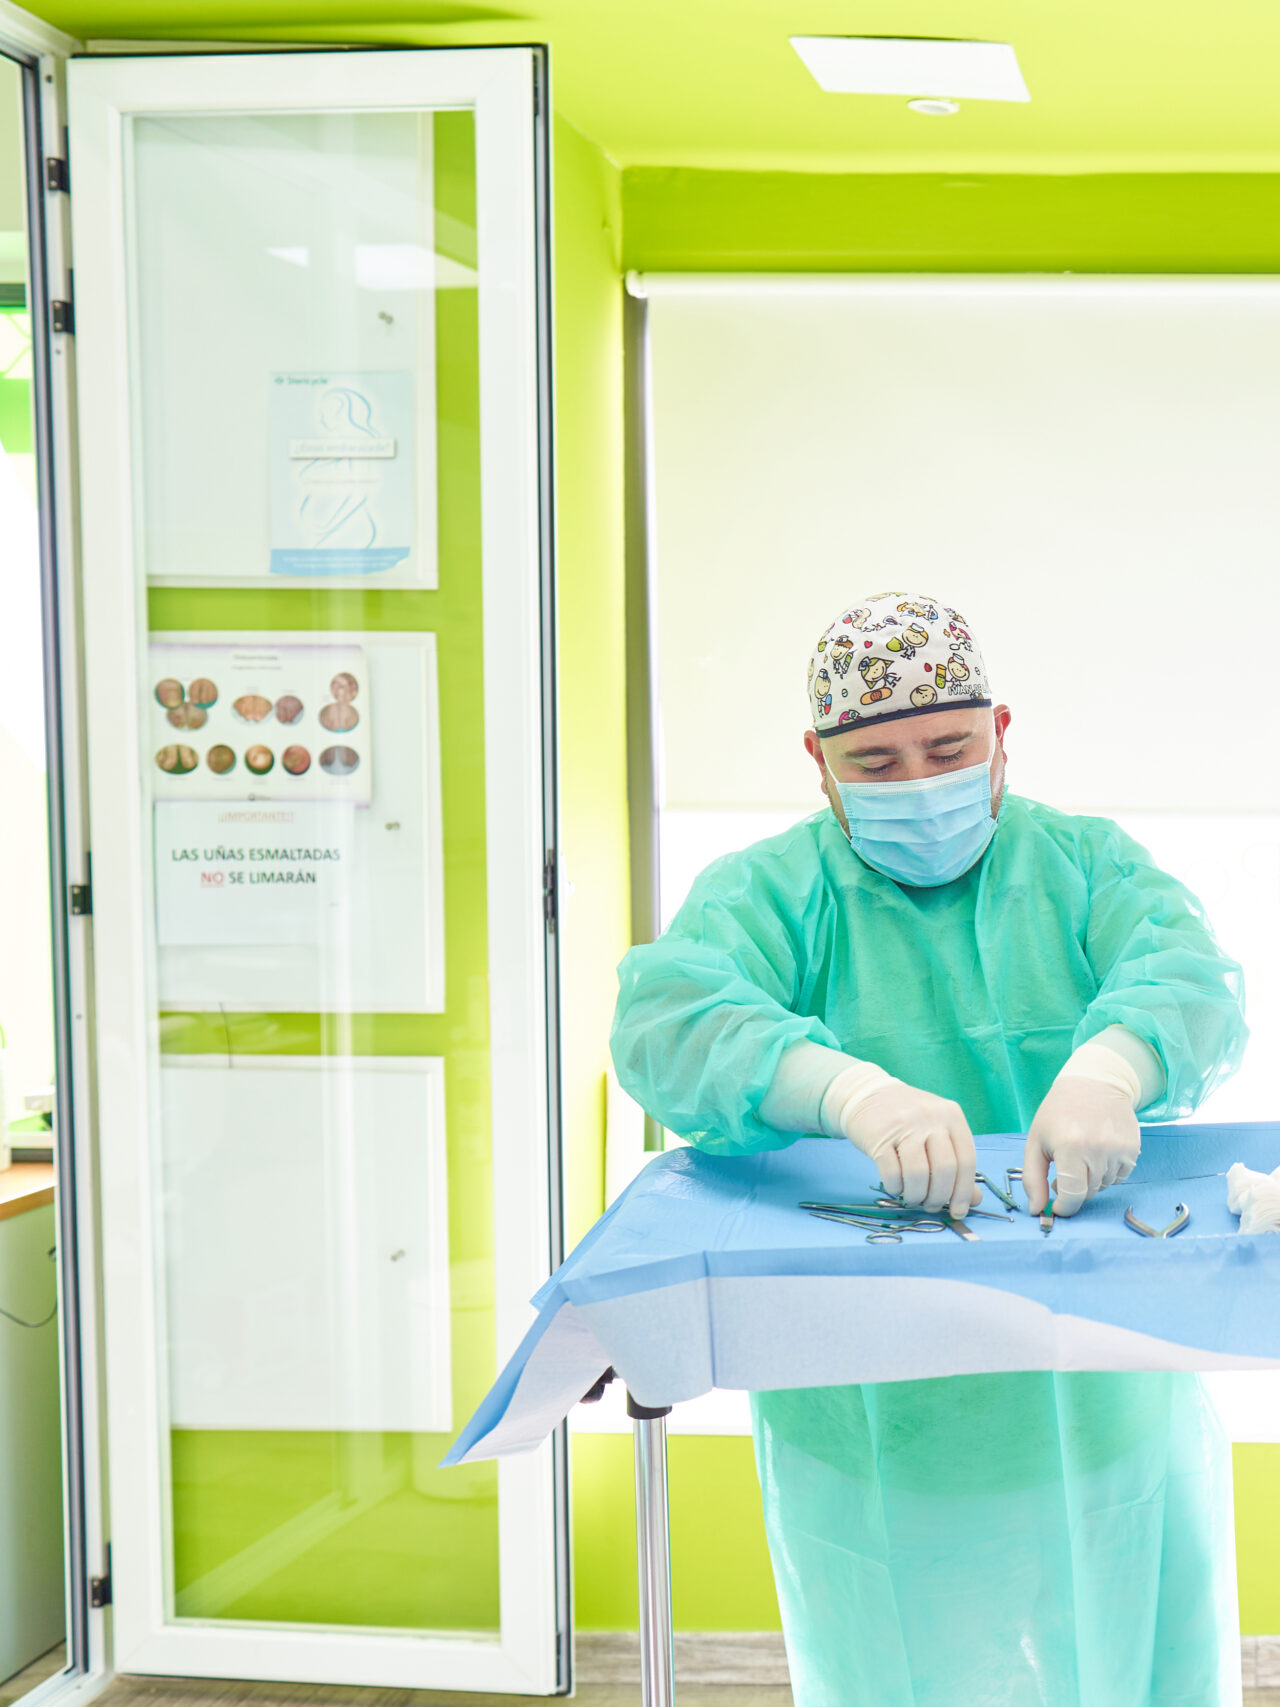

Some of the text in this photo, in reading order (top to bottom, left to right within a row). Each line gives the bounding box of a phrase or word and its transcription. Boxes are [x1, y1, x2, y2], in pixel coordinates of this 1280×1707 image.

[171, 844, 341, 861] LAS UÑAS ESMALTADAS
[200, 868, 316, 886] NO SE LIMARÁN
